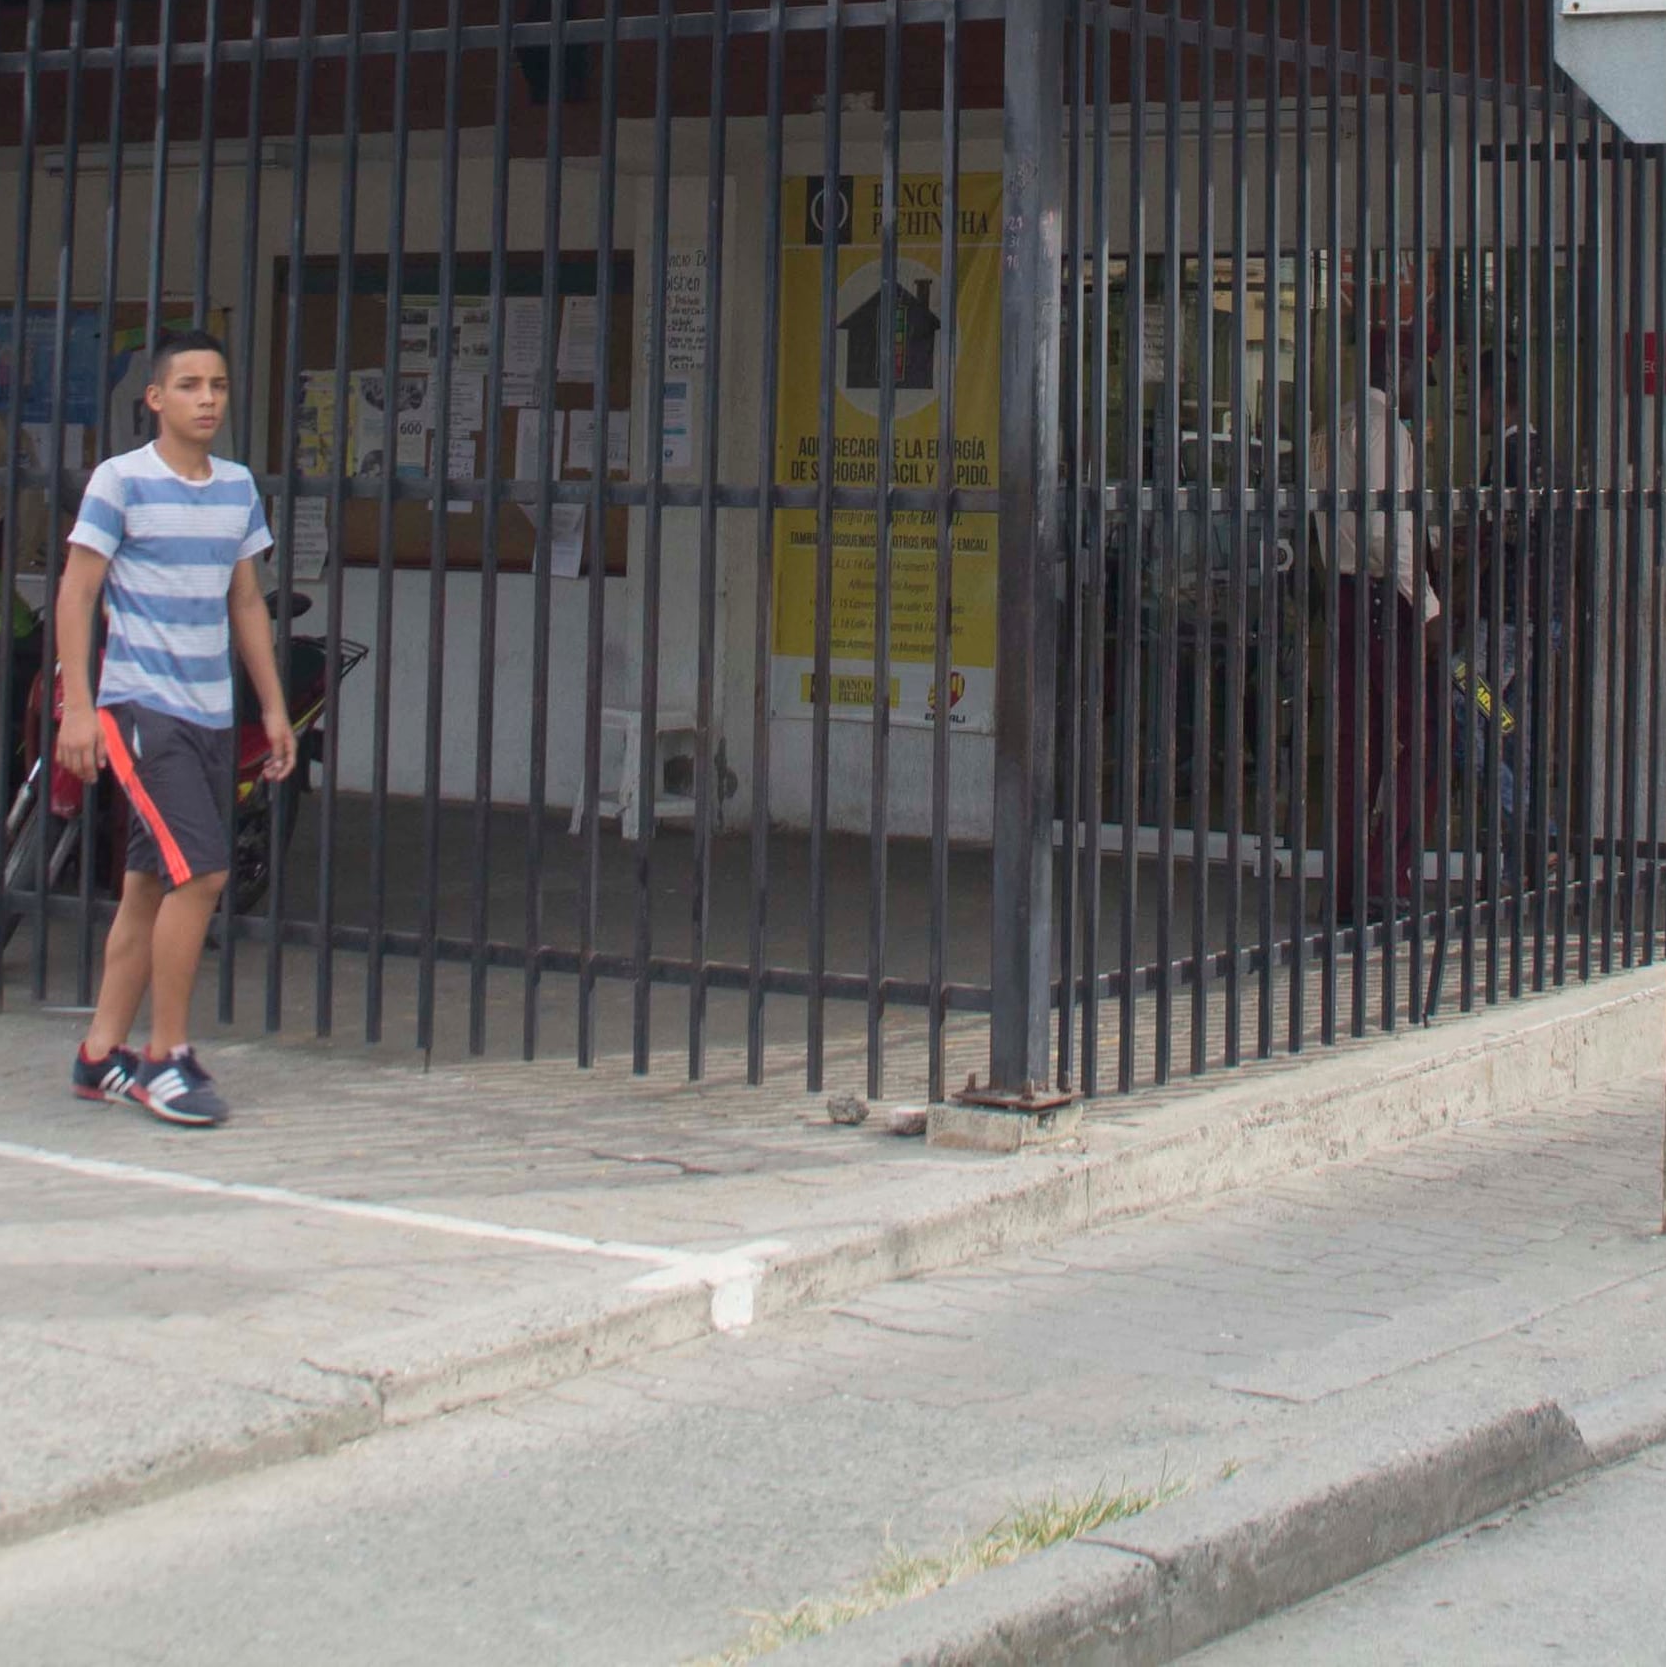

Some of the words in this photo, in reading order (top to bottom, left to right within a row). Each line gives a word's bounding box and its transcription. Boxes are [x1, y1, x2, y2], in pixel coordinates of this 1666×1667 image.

[873, 181, 948, 208] BNCO
[872, 210, 990, 237] PCHINHA
[927, 436, 985, 462] ERGÍA
